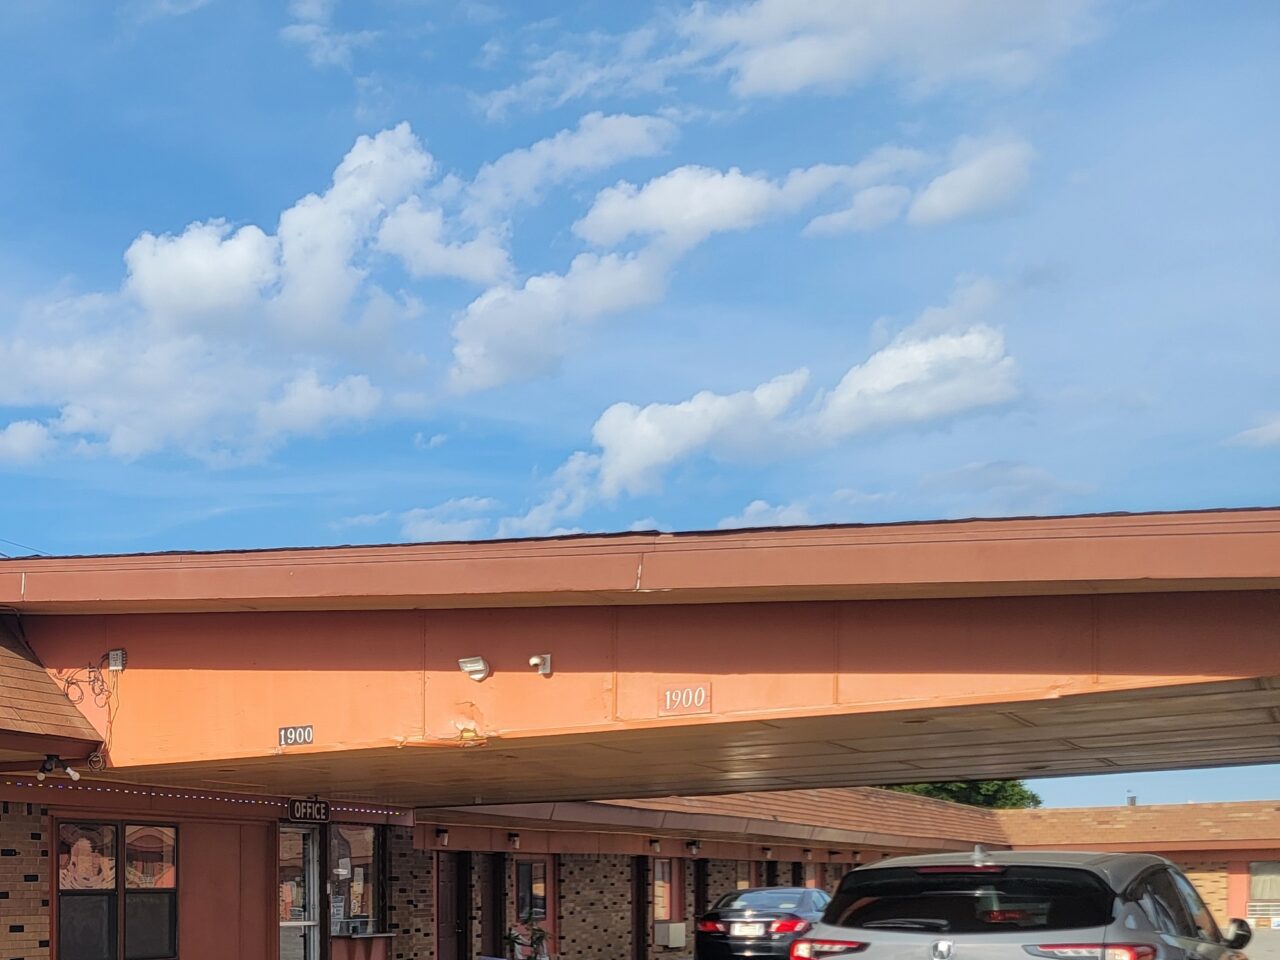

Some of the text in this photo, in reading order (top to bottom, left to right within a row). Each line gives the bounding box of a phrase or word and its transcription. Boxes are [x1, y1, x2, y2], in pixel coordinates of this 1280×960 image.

[665, 687, 705, 710] 1900
[280, 727, 313, 744] 1900
[294, 801, 326, 819] OFFICE
